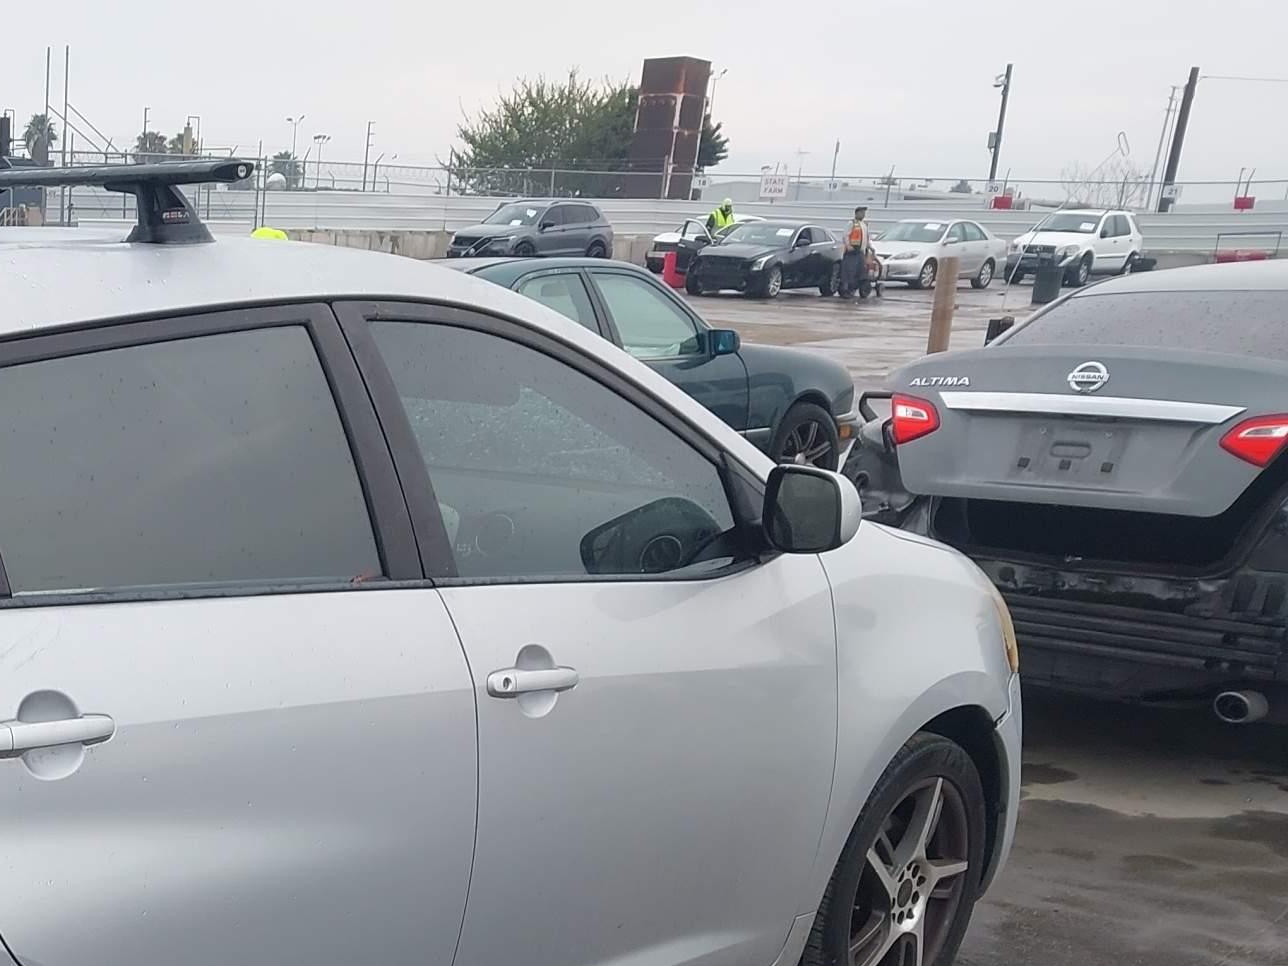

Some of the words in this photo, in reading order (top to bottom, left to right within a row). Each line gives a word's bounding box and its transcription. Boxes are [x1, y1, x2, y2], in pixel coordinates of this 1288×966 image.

[764, 177, 785, 185] STATE
[988, 185, 999, 193] 20
[908, 376, 971, 386] ALTIMA
